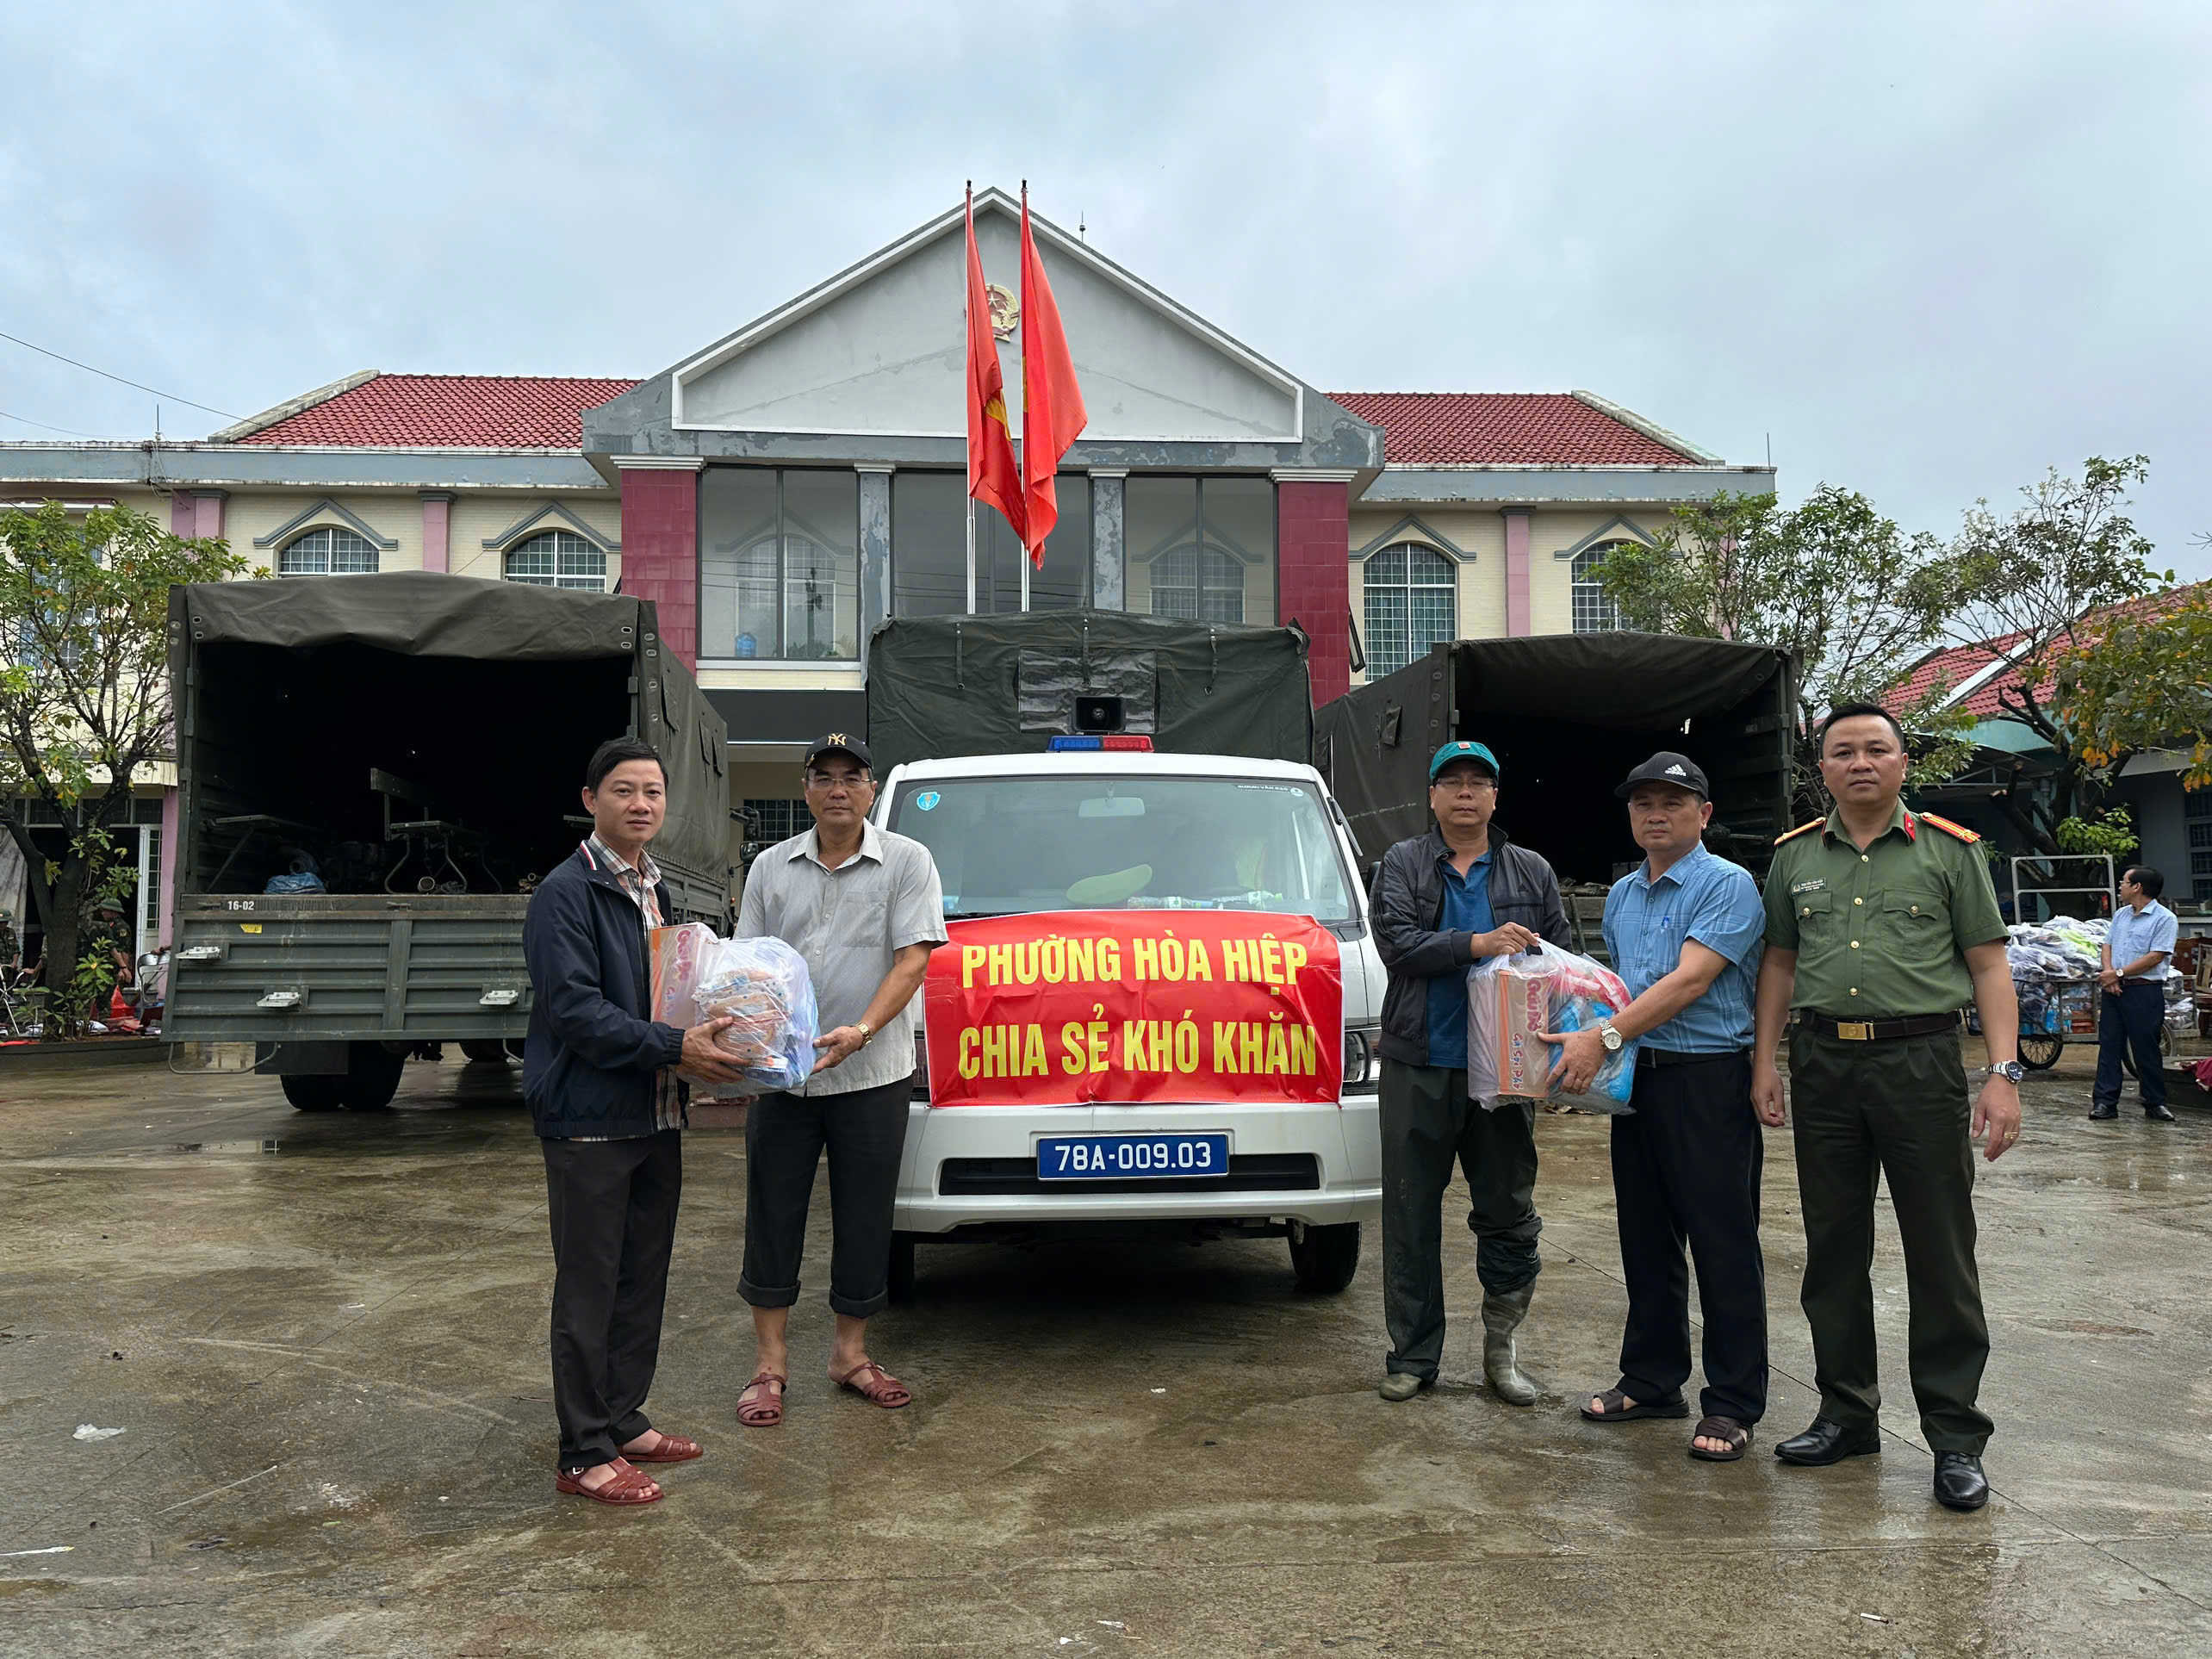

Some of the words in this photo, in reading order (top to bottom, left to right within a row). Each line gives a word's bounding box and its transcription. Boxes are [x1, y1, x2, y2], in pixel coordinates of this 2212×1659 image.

[227, 900, 255, 910] 16-02
[962, 934, 1122, 988] PHƯỜNG
[1133, 929, 1214, 981] HÒA
[1221, 933, 1308, 996] HIỆP
[959, 1024, 1049, 1080] CHIA
[1061, 1003, 1109, 1074] SẺ
[1123, 1010, 1200, 1073] KHÓ
[1214, 1011, 1316, 1076] KHĂN
[1054, 1141, 1211, 1171] 78A-009.03
